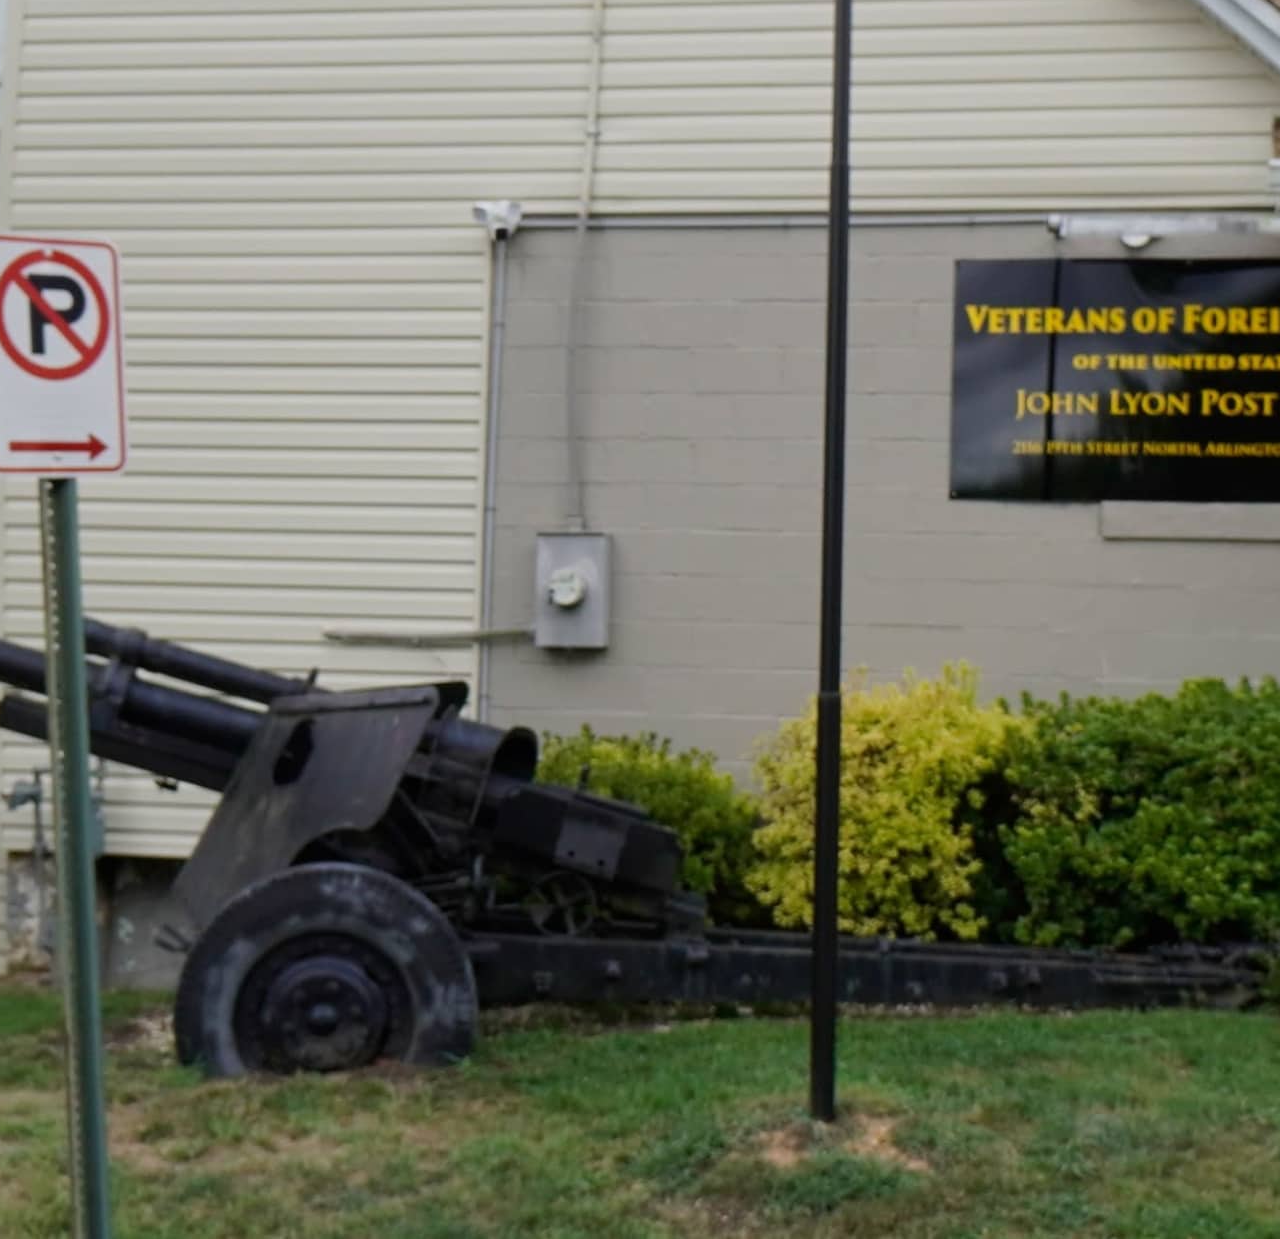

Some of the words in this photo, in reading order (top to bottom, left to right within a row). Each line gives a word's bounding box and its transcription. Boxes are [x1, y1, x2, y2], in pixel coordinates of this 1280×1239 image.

[26, 273, 86, 355] P
[966, 304, 1126, 334] VETERANS
[1131, 307, 1175, 333] OF
[1072, 354, 1102, 370] OF
[1106, 354, 1148, 370] THE
[1152, 354, 1236, 371] UNITED
[1015, 390, 1099, 419] JOHN
[1109, 390, 1190, 416] LYON
[1200, 389, 1278, 416] POST
[1086, 440, 1139, 456] STREET
